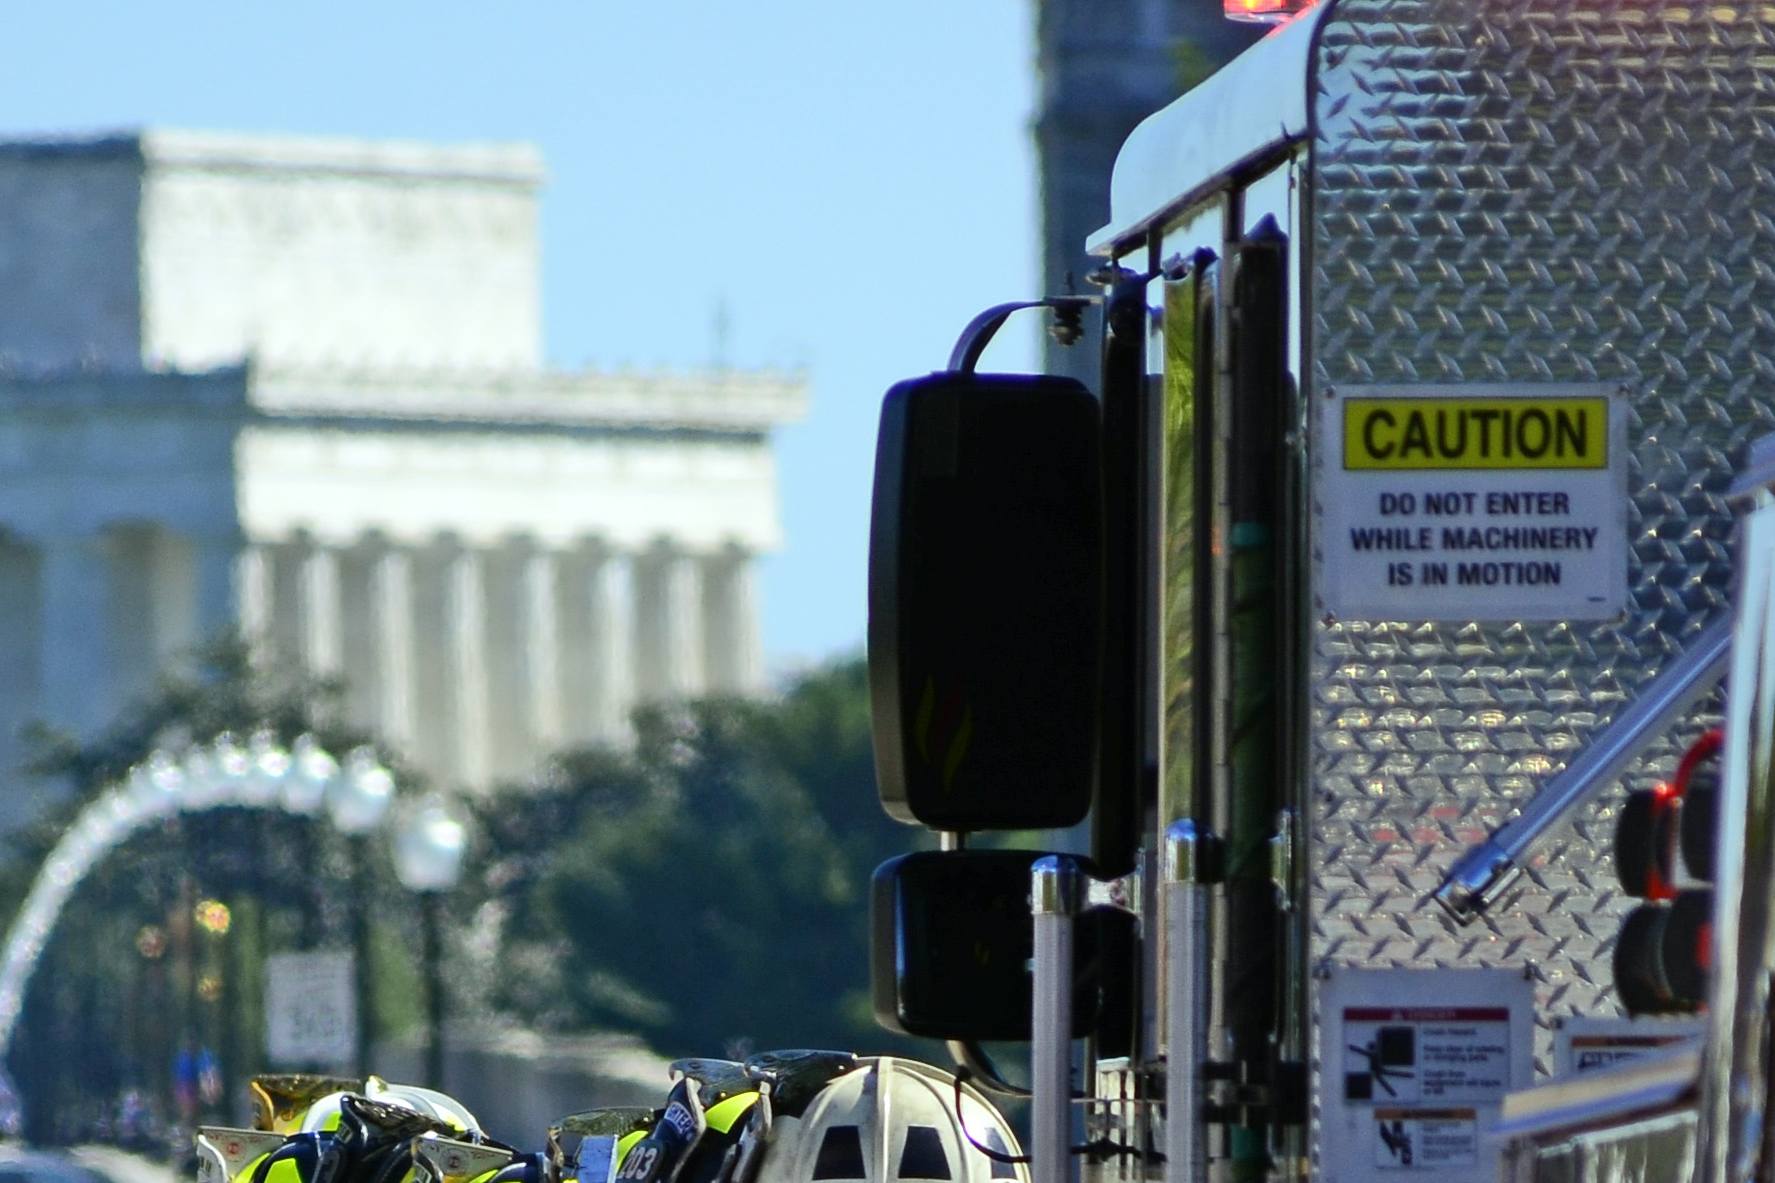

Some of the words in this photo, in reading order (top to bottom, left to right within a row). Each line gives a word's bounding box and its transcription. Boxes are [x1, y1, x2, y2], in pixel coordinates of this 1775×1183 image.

[1363, 409, 1587, 459] CAUTION
[1379, 492, 1416, 516] DO
[1425, 492, 1476, 516] NOT
[1486, 492, 1570, 516] ENTER
[1351, 527, 1433, 551] WHILE
[1442, 527, 1599, 551] MACHINERY
[1388, 562, 1413, 586] IS
[1423, 562, 1447, 586] IN
[1457, 562, 1561, 586] MOTION
[617, 1147, 659, 1180] 203
